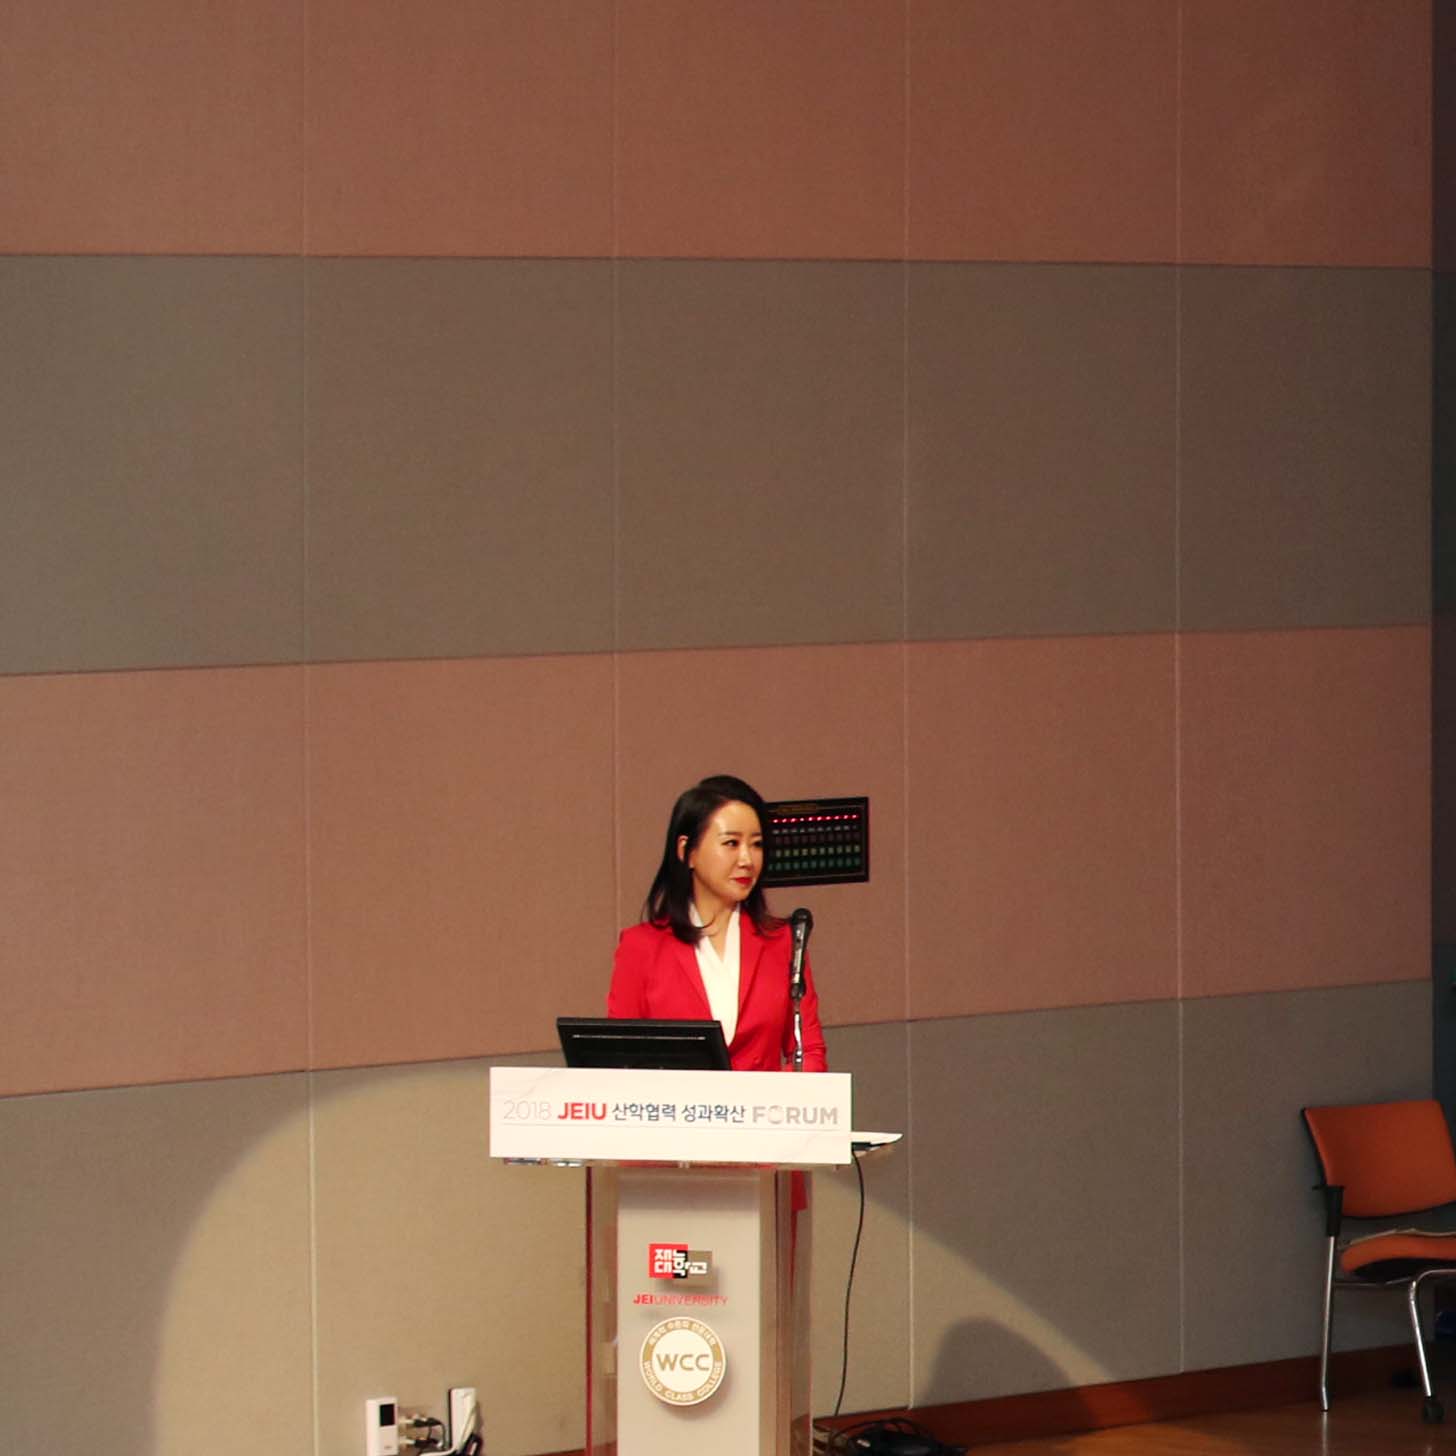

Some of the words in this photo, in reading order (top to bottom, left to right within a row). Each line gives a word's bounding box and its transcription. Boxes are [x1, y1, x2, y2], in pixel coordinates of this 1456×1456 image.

[504, 1100, 551, 1120] 2018
[558, 1102, 607, 1120] JEIU
[612, 1103, 676, 1121] 산학협력
[681, 1104, 746, 1123] 성과확산
[752, 1105, 838, 1125] FORUM
[656, 1353, 710, 1371] WCC
